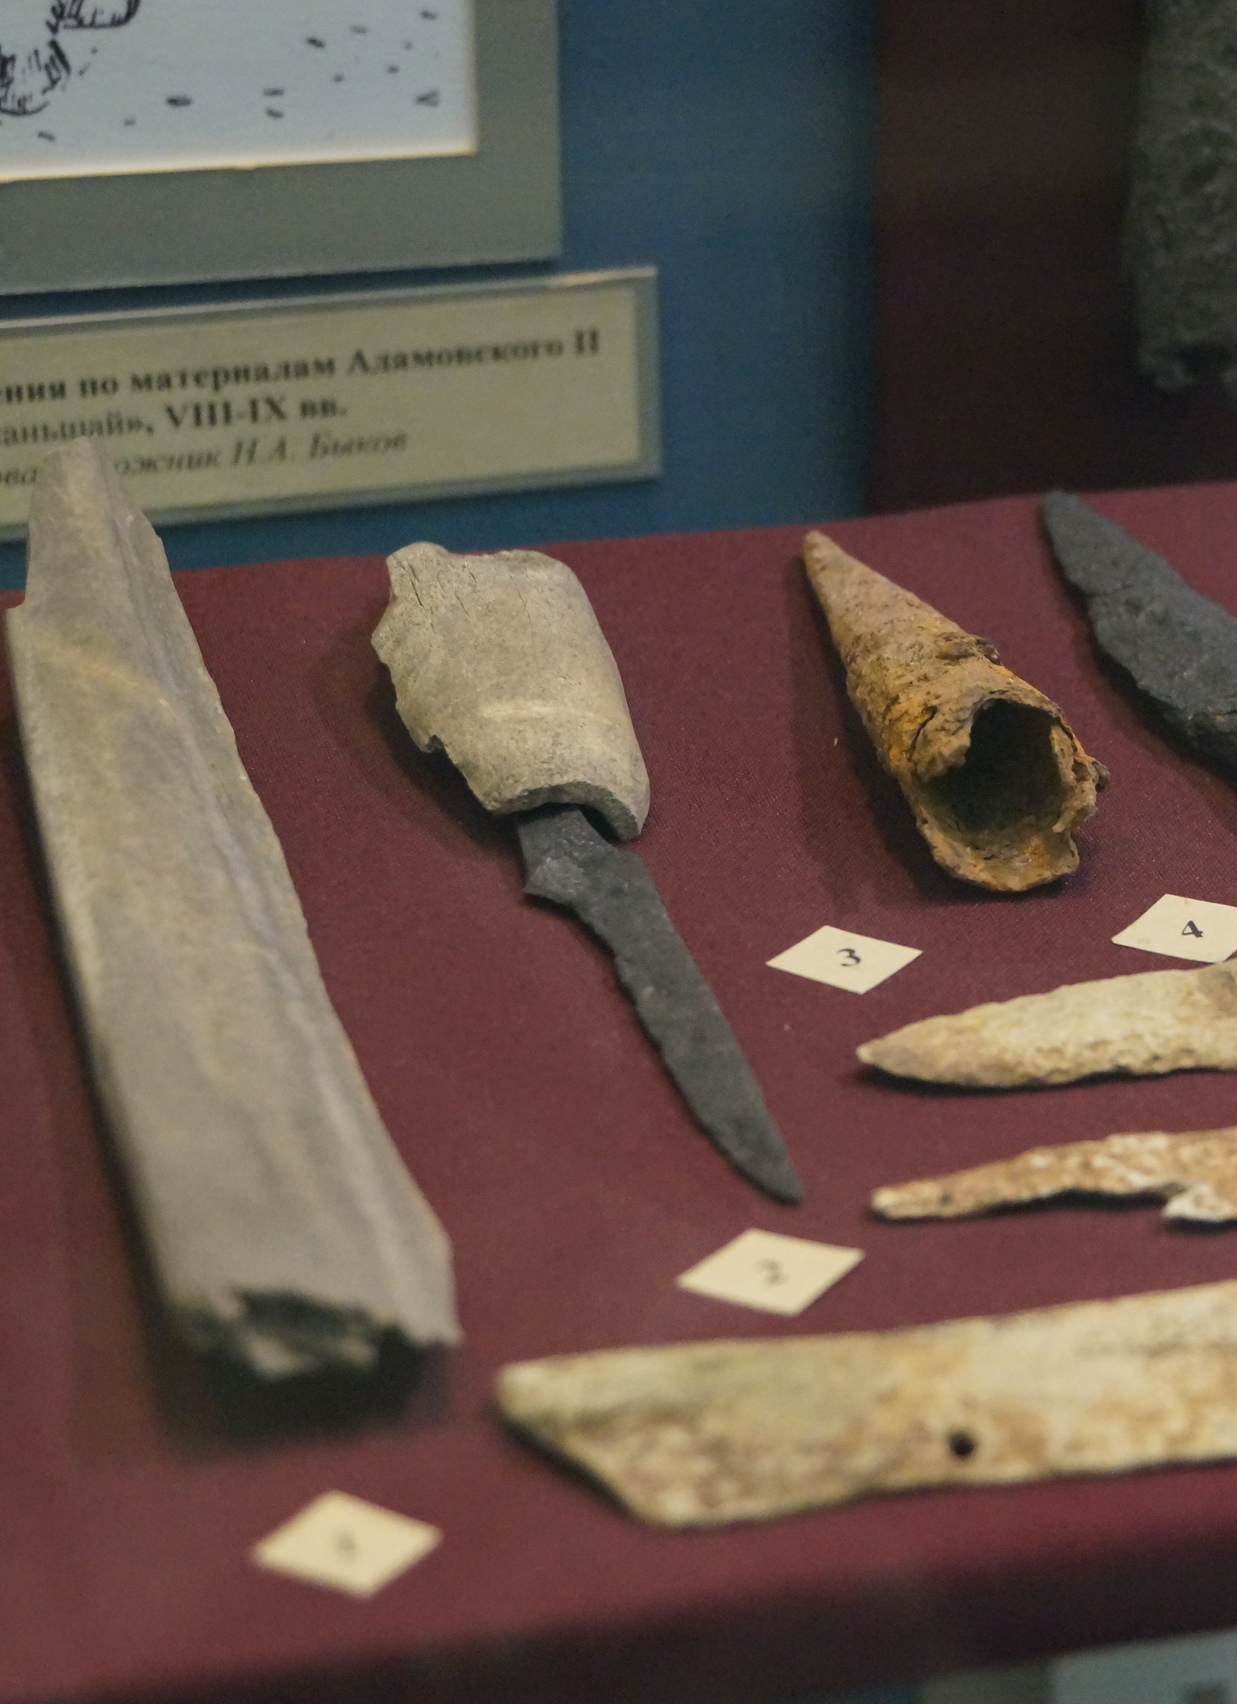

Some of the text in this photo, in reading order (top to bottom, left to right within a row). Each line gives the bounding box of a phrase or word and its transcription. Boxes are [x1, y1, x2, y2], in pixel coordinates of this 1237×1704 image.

[0, 377, 67, 404] ния
[79, 373, 120, 399] по
[130, 355, 336, 393] материалам
[348, 338, 564, 376] Адамовского
[165, 395, 287, 428] VIII-IX
[1181, 919, 1204, 939] 4
[836, 947, 863, 968] 3
